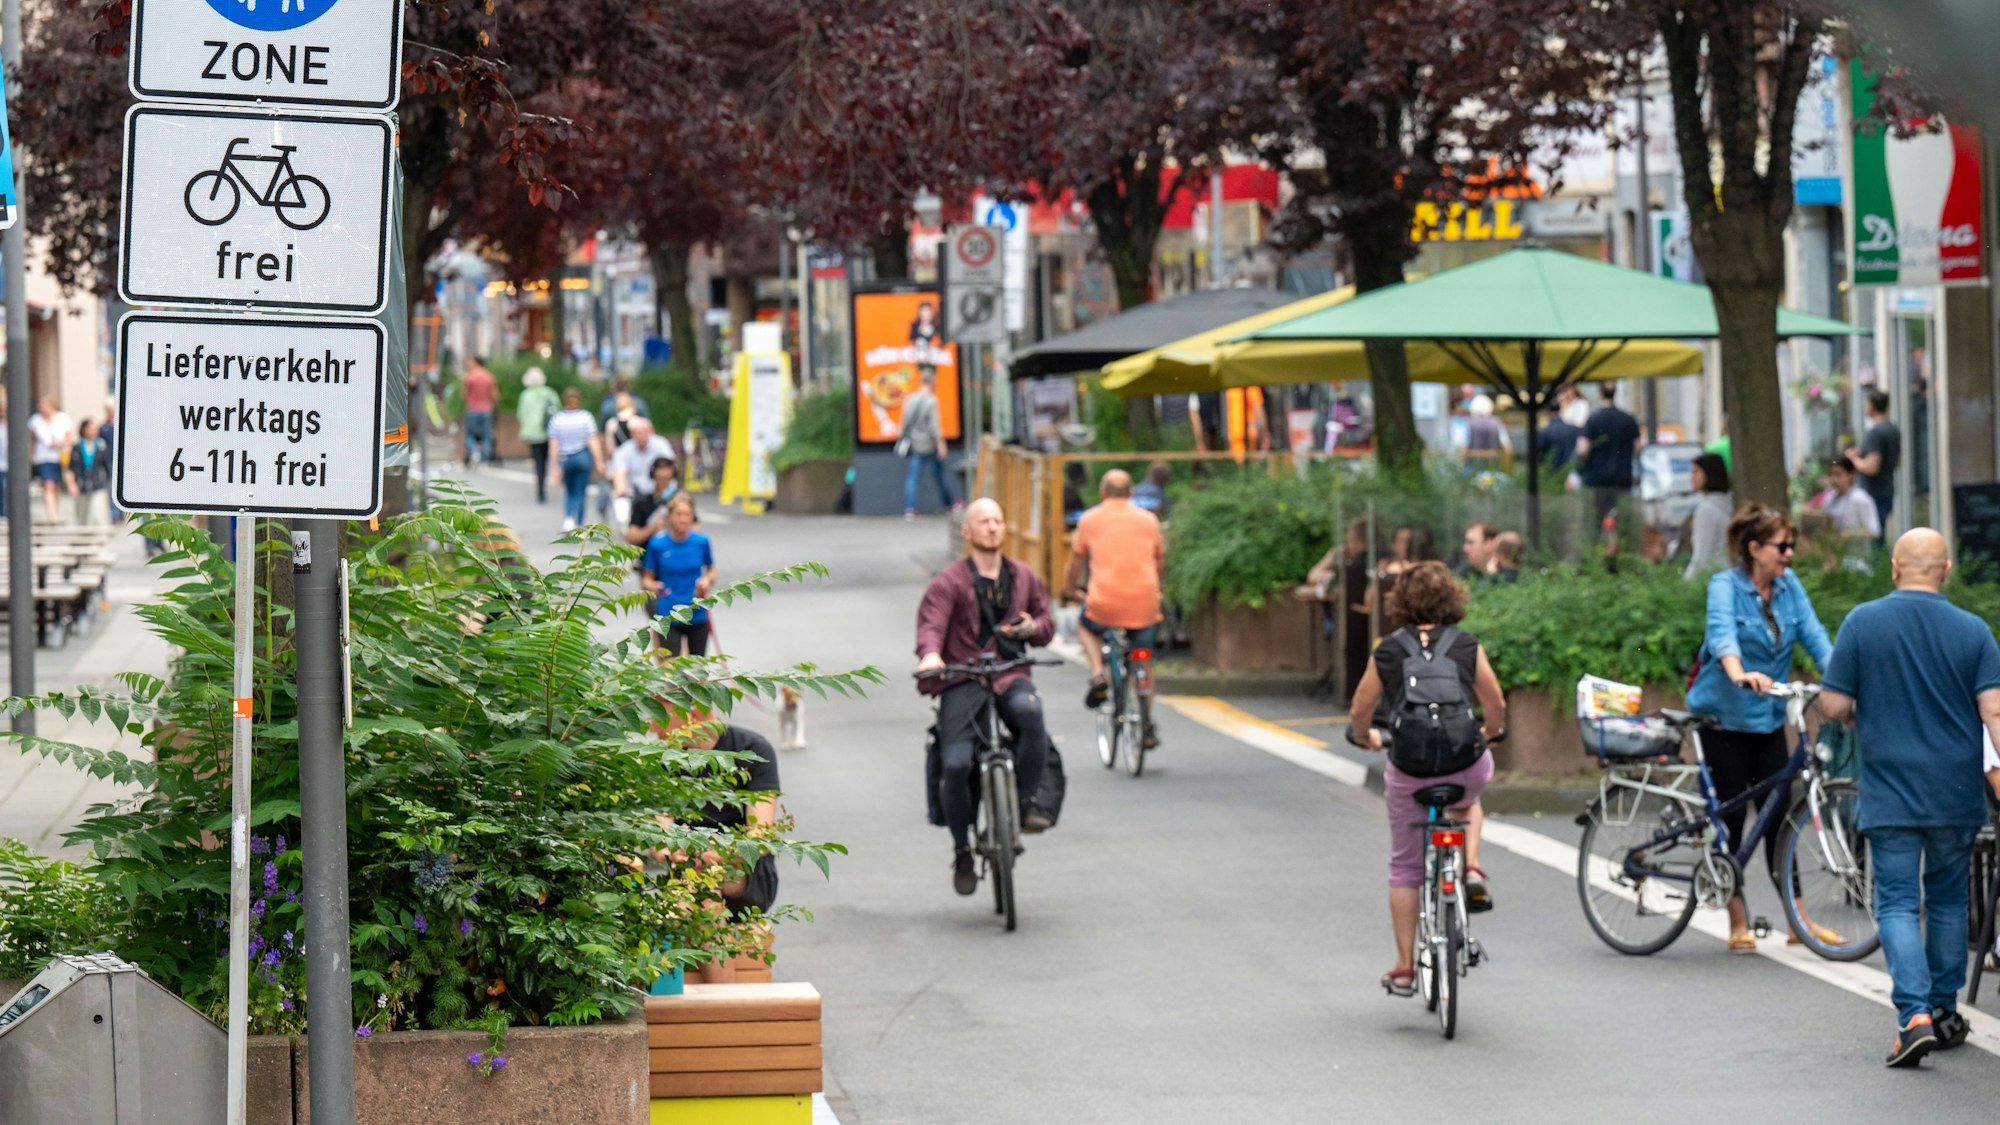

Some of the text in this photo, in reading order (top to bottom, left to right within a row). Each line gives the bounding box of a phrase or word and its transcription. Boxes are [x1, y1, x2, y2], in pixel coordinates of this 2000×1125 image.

[201, 40, 330, 86] ZONE
[216, 240, 294, 282] frei
[147, 342, 356, 384] Lieferverkehr
[179, 398, 321, 444] werktags
[275, 451, 327, 487] frei
